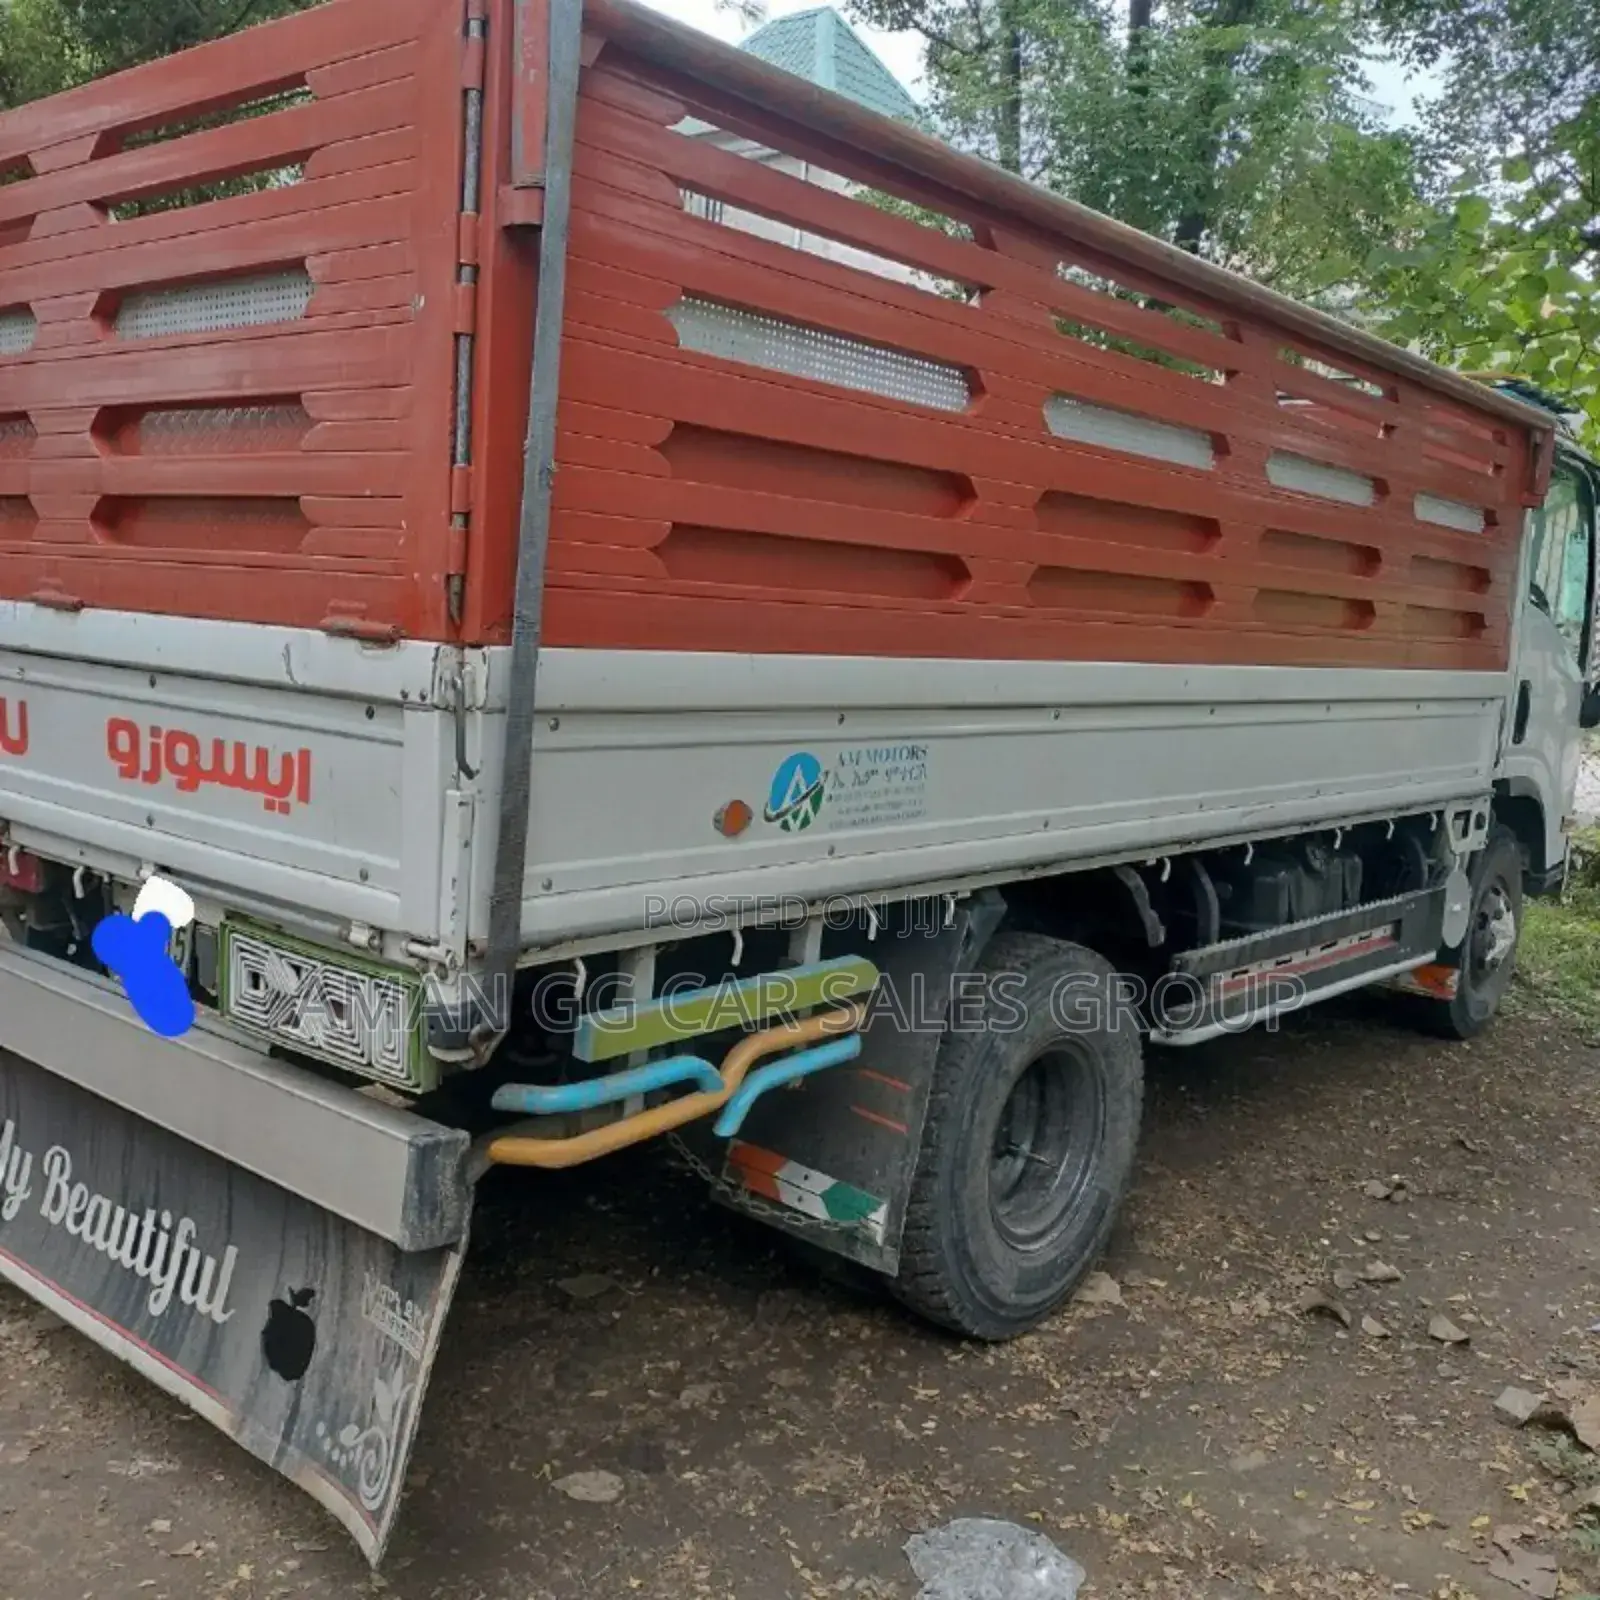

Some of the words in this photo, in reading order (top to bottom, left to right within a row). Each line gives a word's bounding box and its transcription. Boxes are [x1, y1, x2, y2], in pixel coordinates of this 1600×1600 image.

[866, 744, 929, 764] MOTORS
[0, 1119, 33, 1221] y
[39, 1145, 237, 1324] Beautiful
